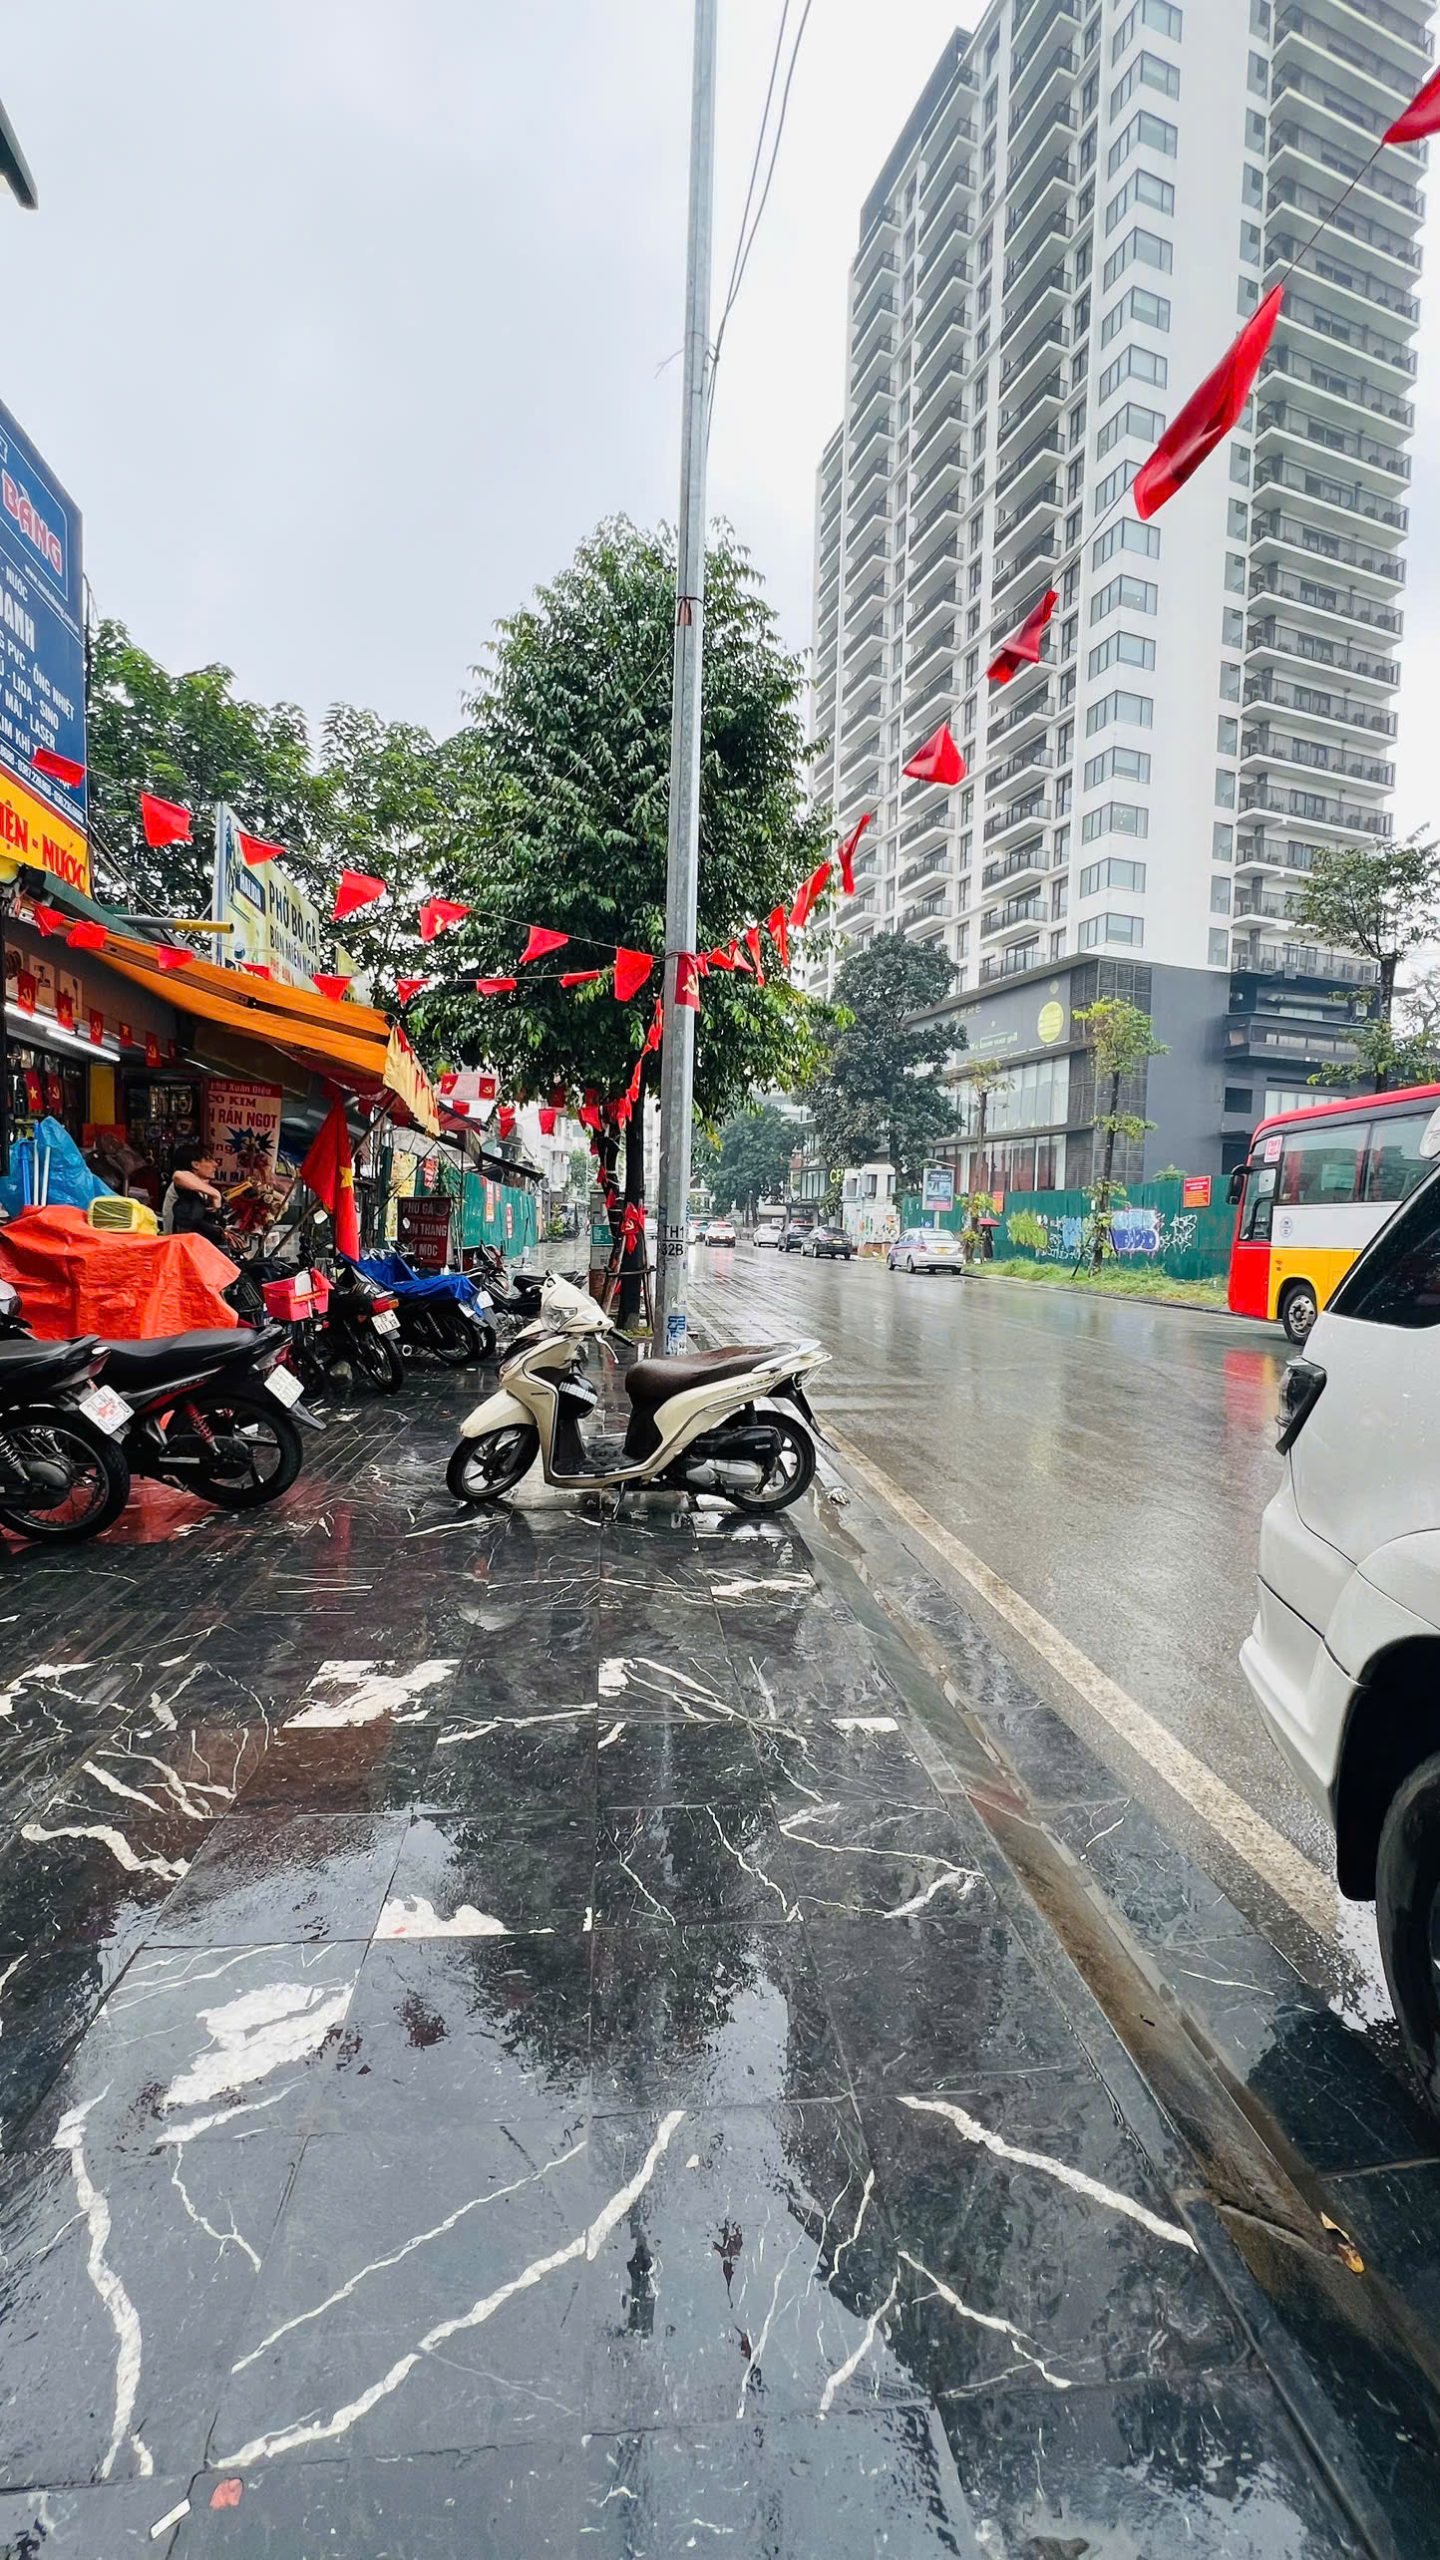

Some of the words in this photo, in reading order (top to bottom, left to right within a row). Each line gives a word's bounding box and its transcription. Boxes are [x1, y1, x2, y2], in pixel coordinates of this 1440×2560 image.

[7, 638, 26, 671] PVC
[30, 713, 56, 751] LASER
[268, 879, 290, 929] PHỞ
[229, 1095, 256, 1108] KIM
[218, 1106, 243, 1125] RÁN
[246, 1111, 278, 1131] NGỌT
[662, 1225, 684, 1239] TH1
[661, 1243, 684, 1256] 32B
